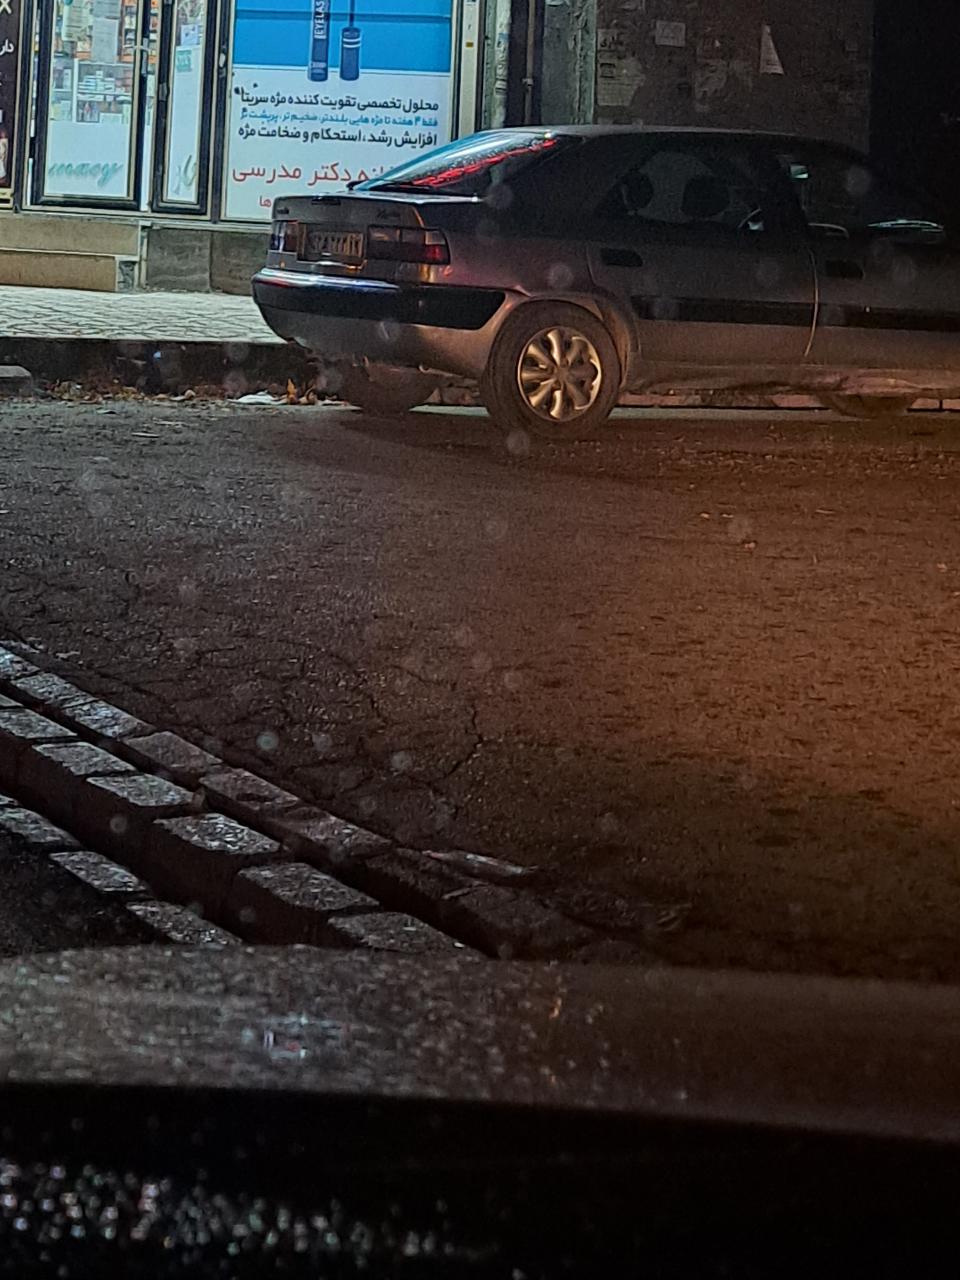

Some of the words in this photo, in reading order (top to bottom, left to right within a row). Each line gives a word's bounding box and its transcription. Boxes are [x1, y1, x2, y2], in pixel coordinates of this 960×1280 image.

[270, 91, 287, 107] مژه
[287, 94, 319, 106] کننده
[320, 95, 357, 110] تقویت
[357, 97, 402, 111] تخصصی
[402, 98, 439, 113] محلول
[238, 125, 256, 141] مژه
[302, 132, 310, 143] و
[310, 129, 362, 144] استحکام
[394, 130, 438, 149] افزایش
[232, 163, 302, 184] مدرسی
[307, 161, 352, 186] دکتر
